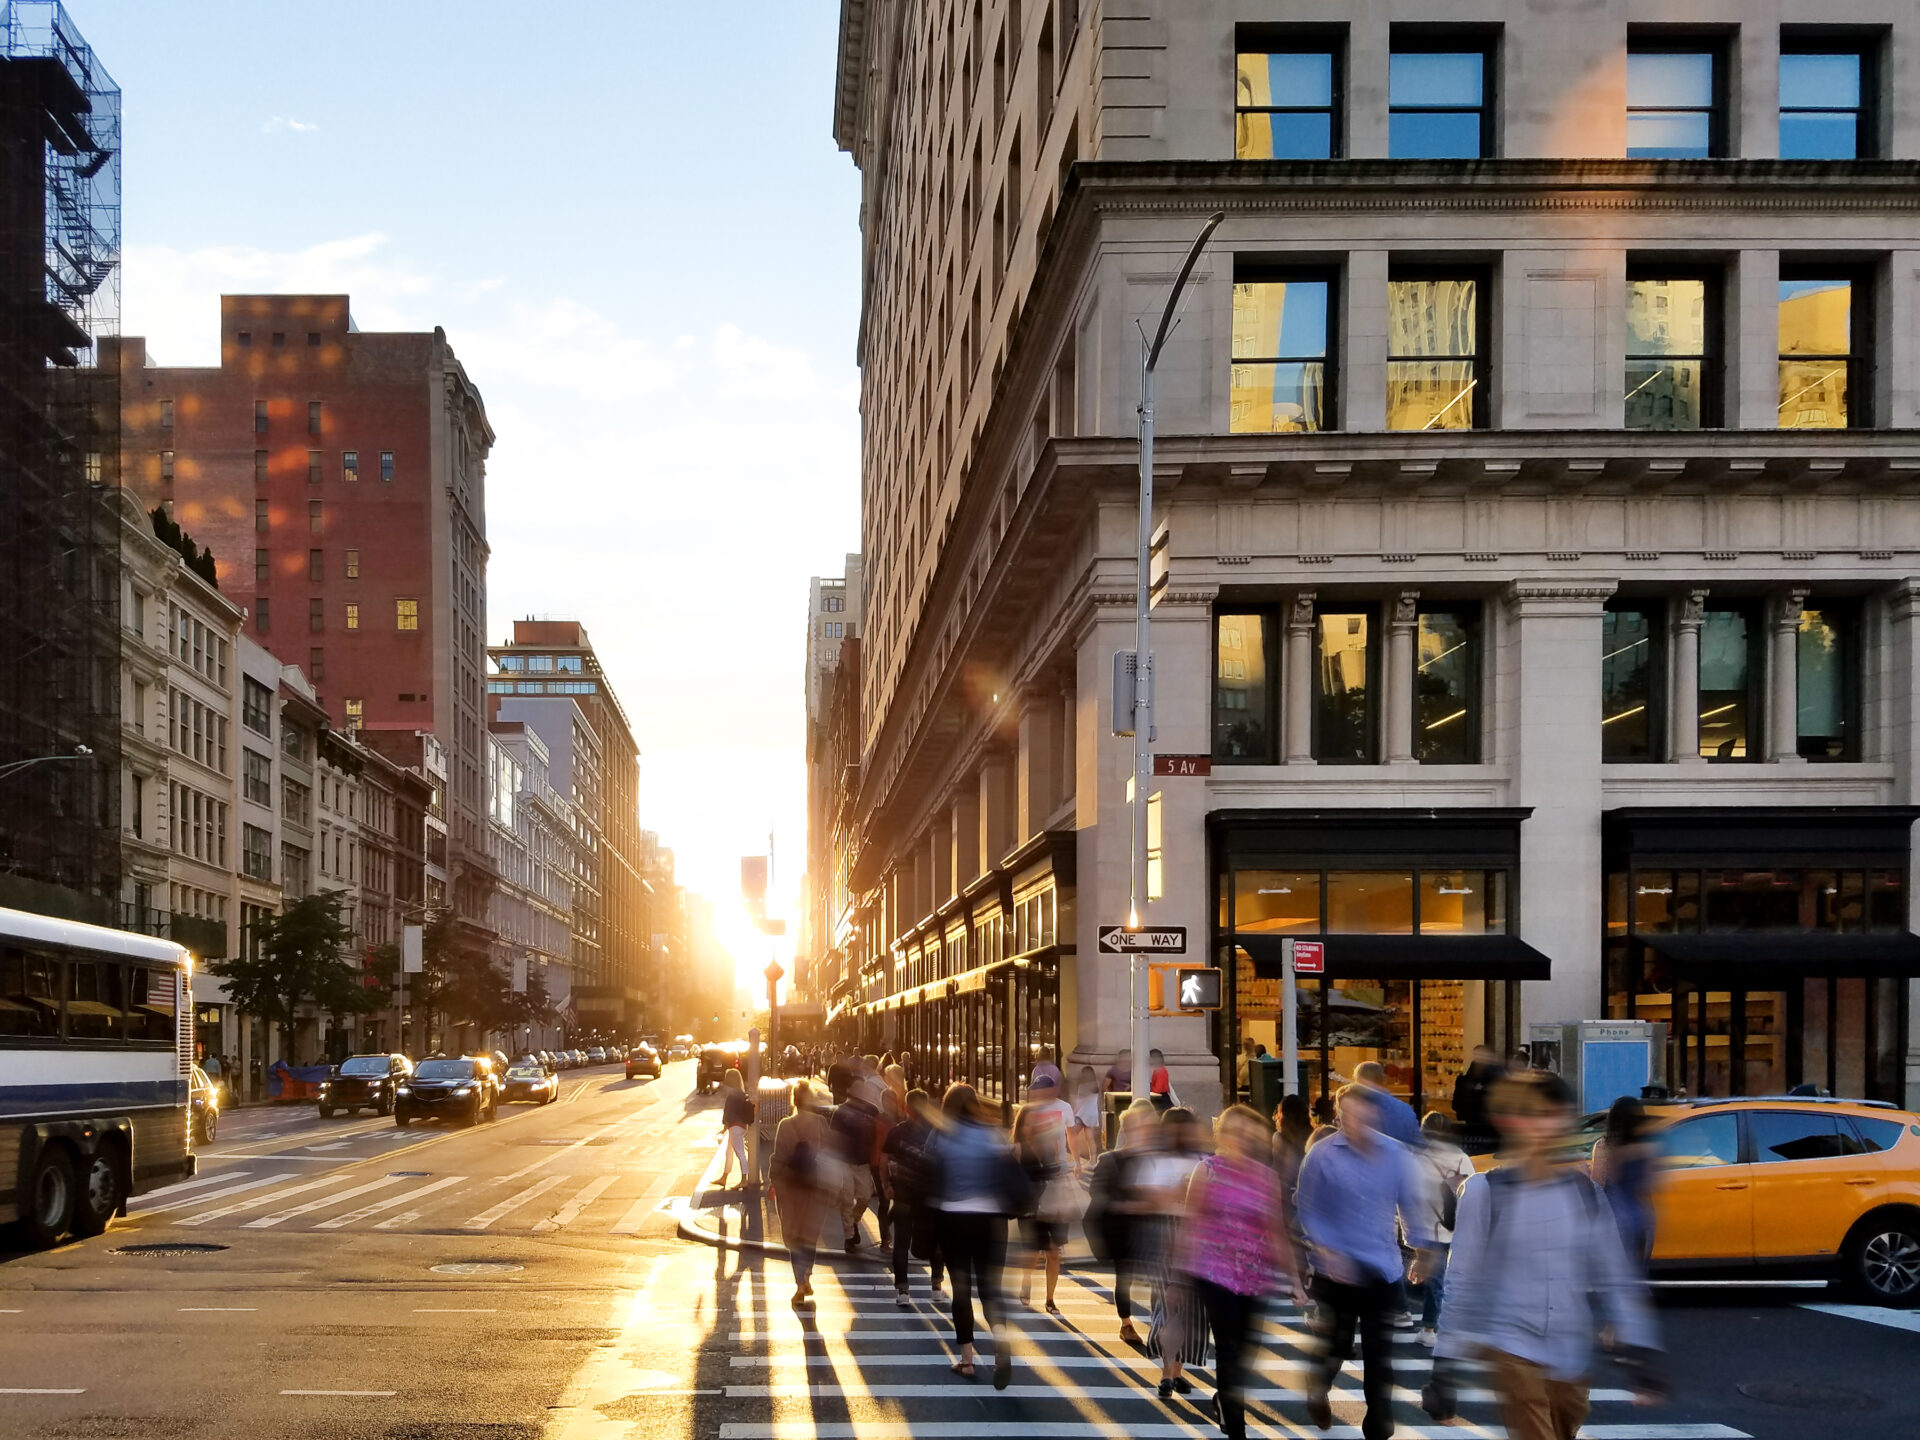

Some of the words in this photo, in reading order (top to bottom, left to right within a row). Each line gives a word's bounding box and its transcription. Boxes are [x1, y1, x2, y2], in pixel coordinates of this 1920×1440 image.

[1168, 759, 1175, 773] 5
[1180, 760, 1196, 774] Av
[1110, 934, 1136, 945] ONE
[1151, 934, 1179, 946] WAY
